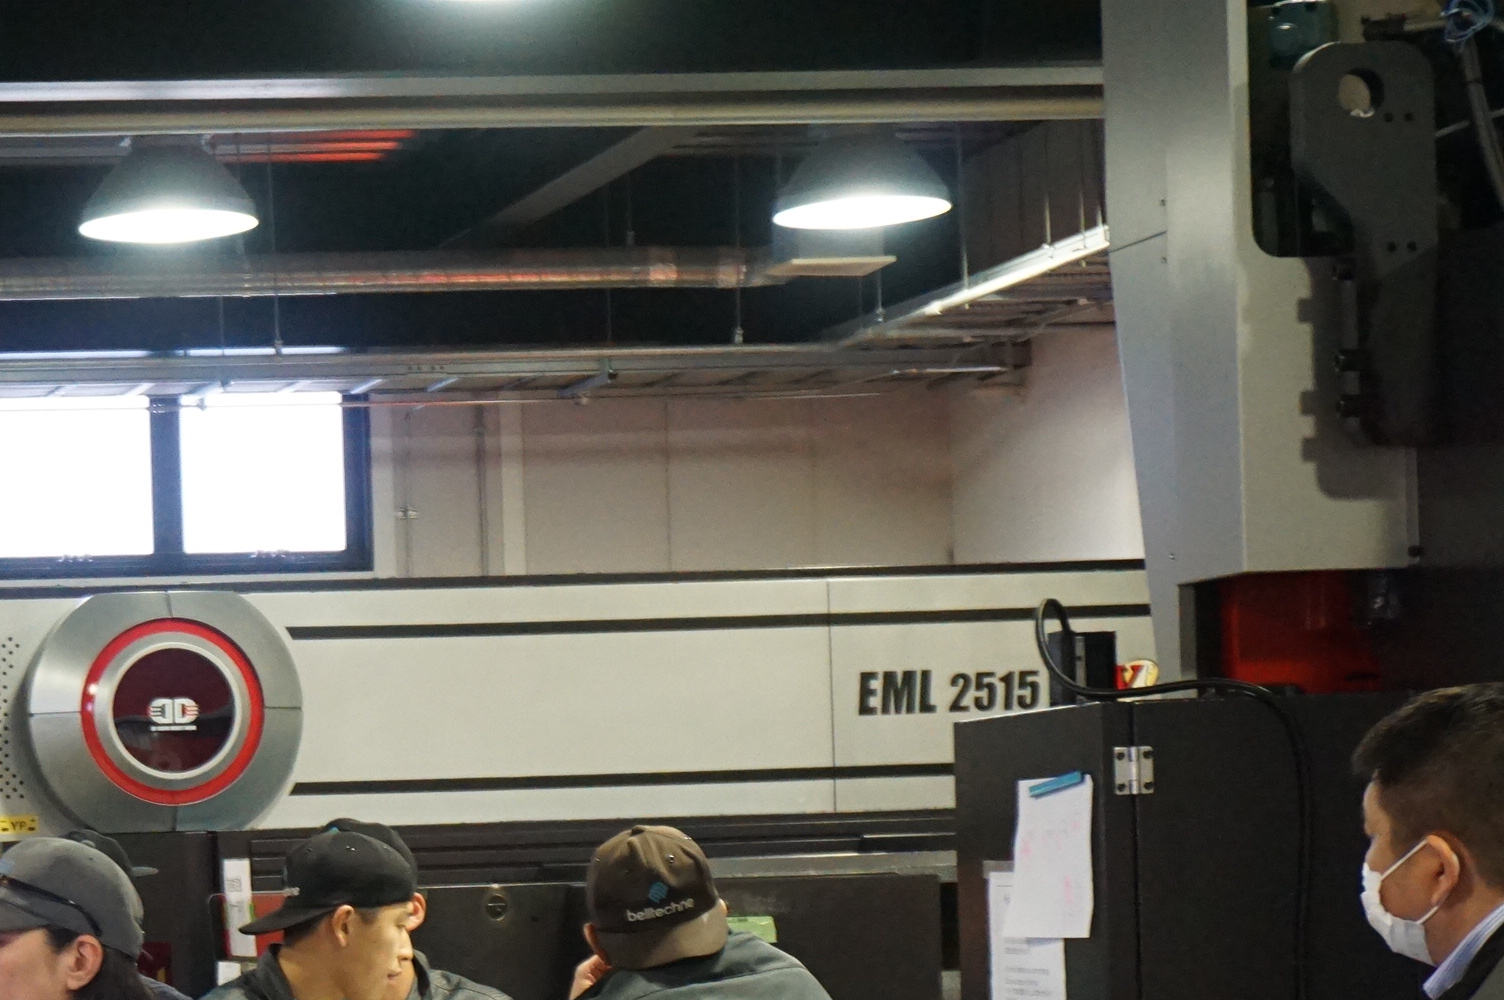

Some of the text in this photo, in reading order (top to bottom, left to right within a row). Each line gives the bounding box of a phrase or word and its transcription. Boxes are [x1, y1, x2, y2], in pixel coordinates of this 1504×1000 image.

[858, 670, 1040, 716] EML 2515
[626, 898, 695, 922] belltechne
